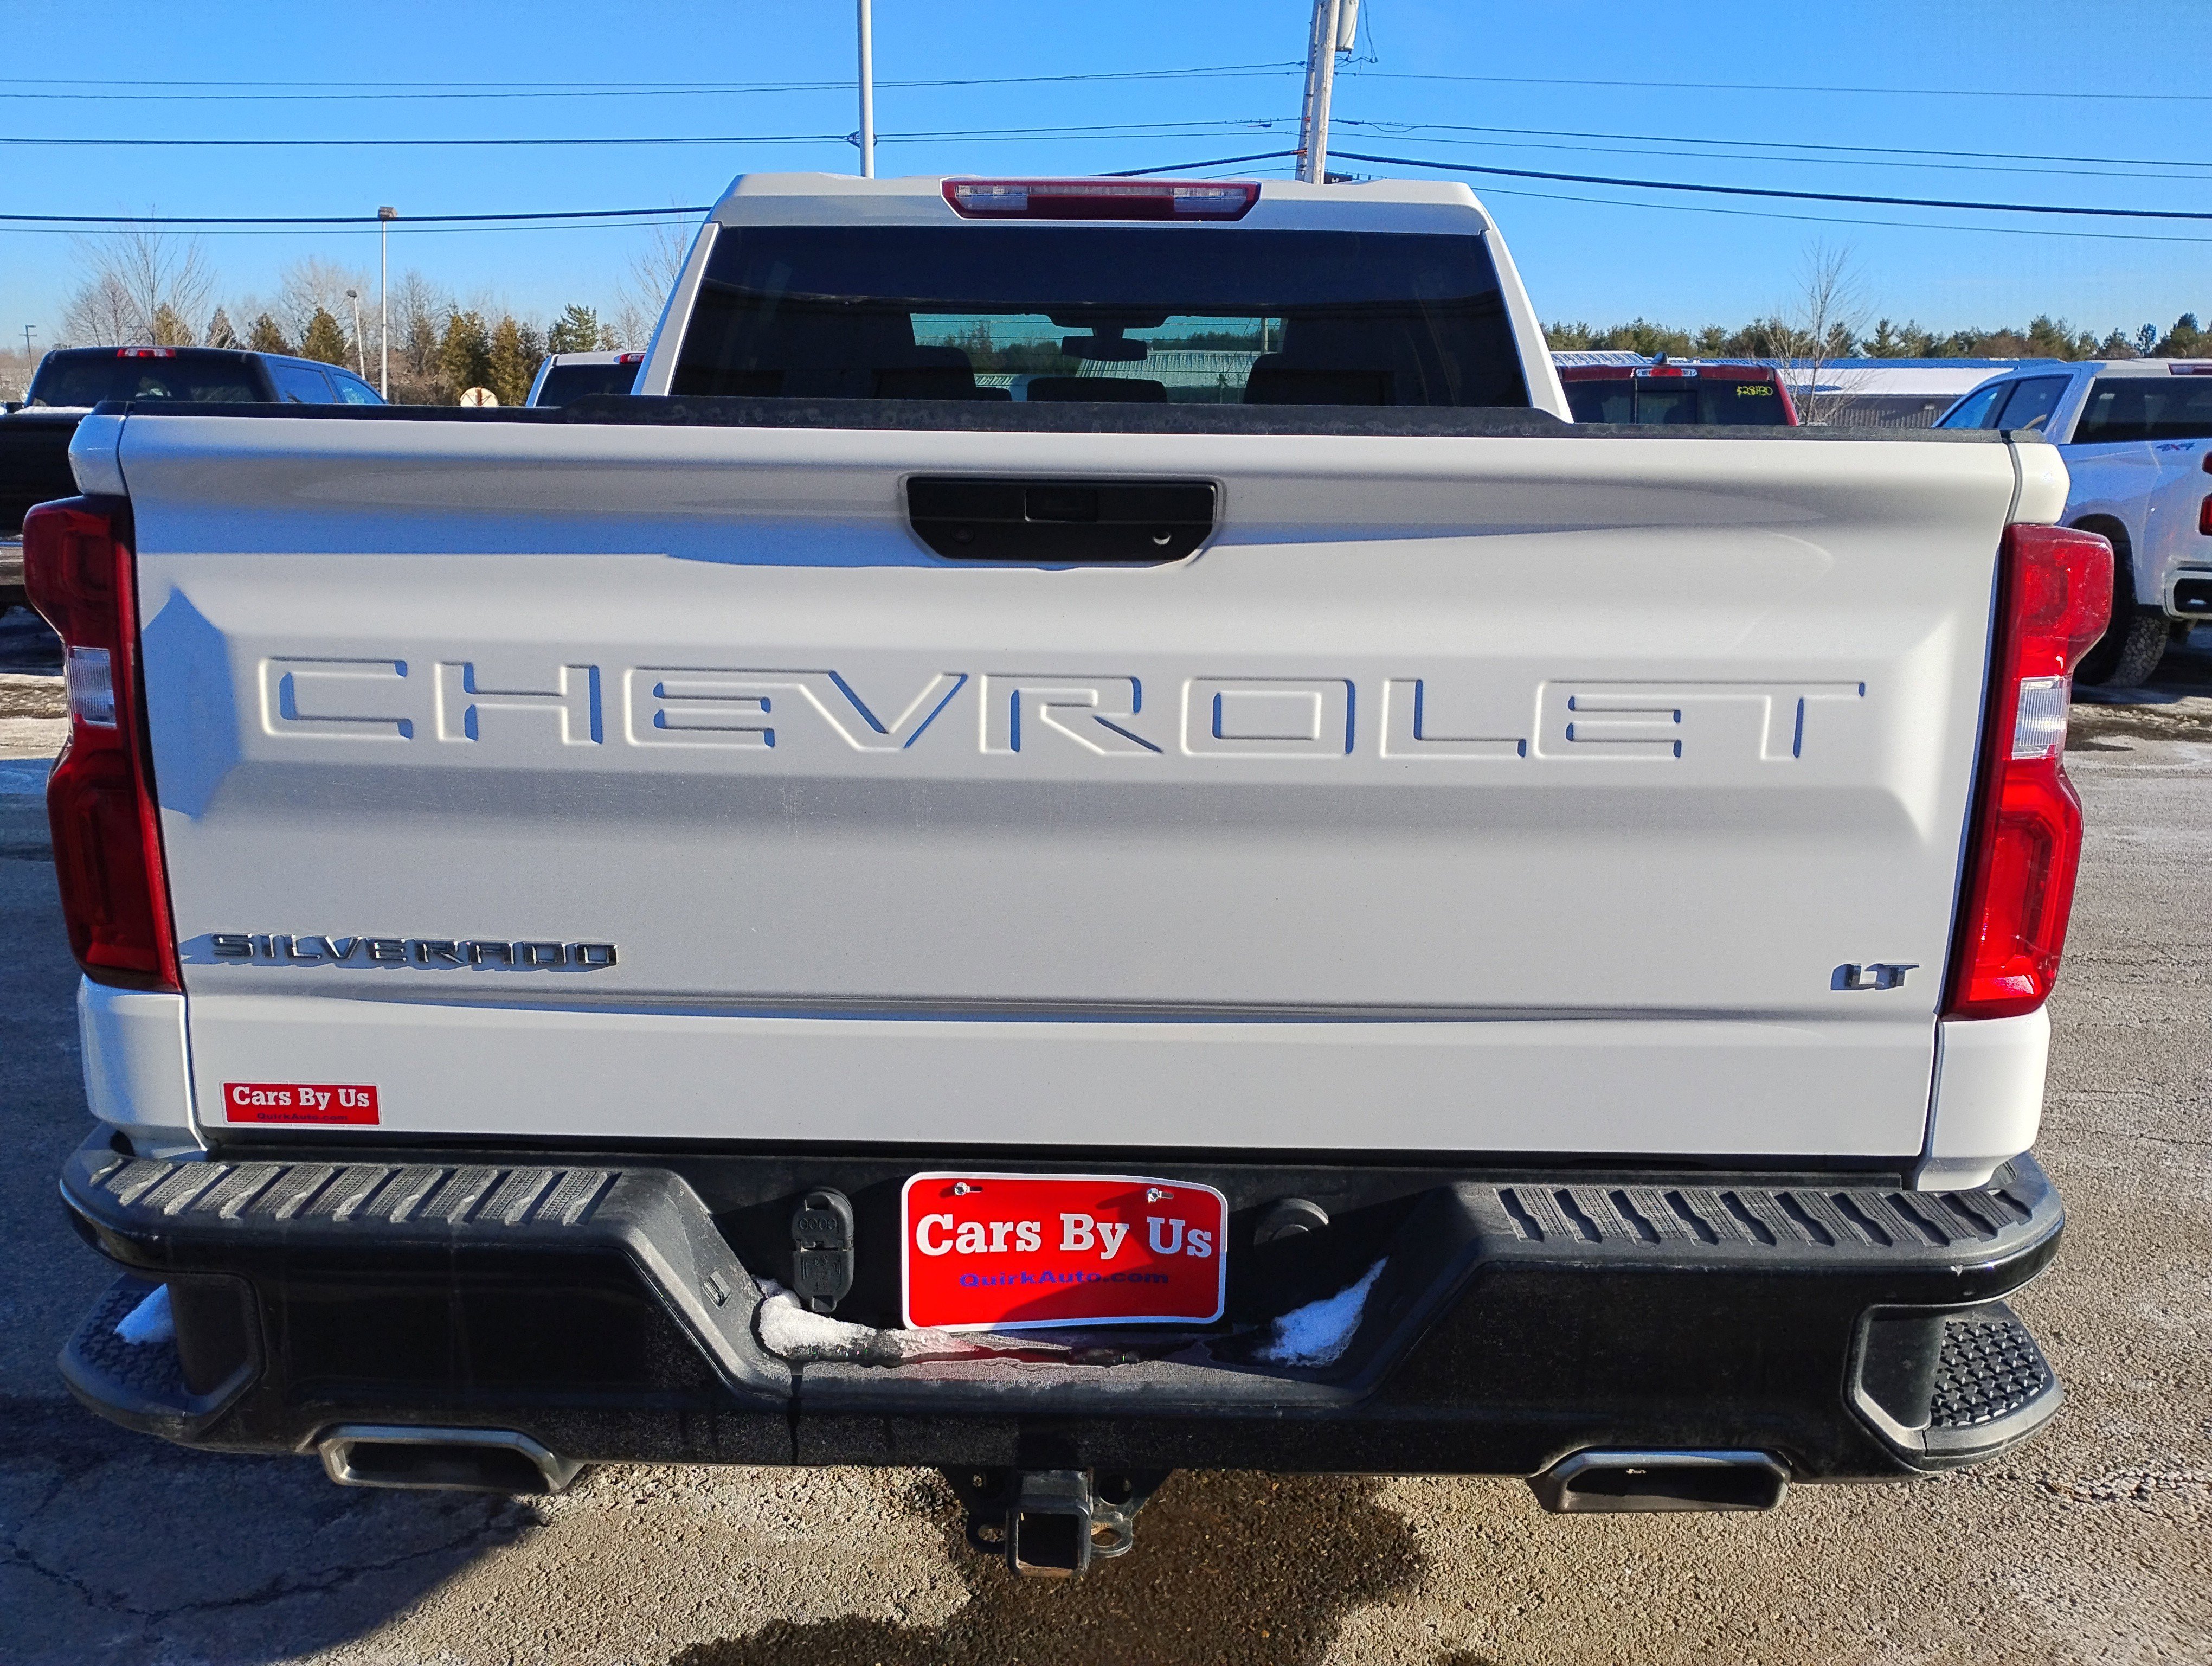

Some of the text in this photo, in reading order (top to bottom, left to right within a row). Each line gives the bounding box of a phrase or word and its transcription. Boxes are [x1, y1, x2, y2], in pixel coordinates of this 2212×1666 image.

[258, 657, 1866, 759] CHEVROLET
[212, 933, 619, 966] SILVERADO
[1840, 963, 1920, 989] LT
[233, 1086, 370, 1110] Cars By Us
[916, 1213, 1212, 1260] Cars By Us
[959, 1270, 1169, 1288] QuirkAuto.com
